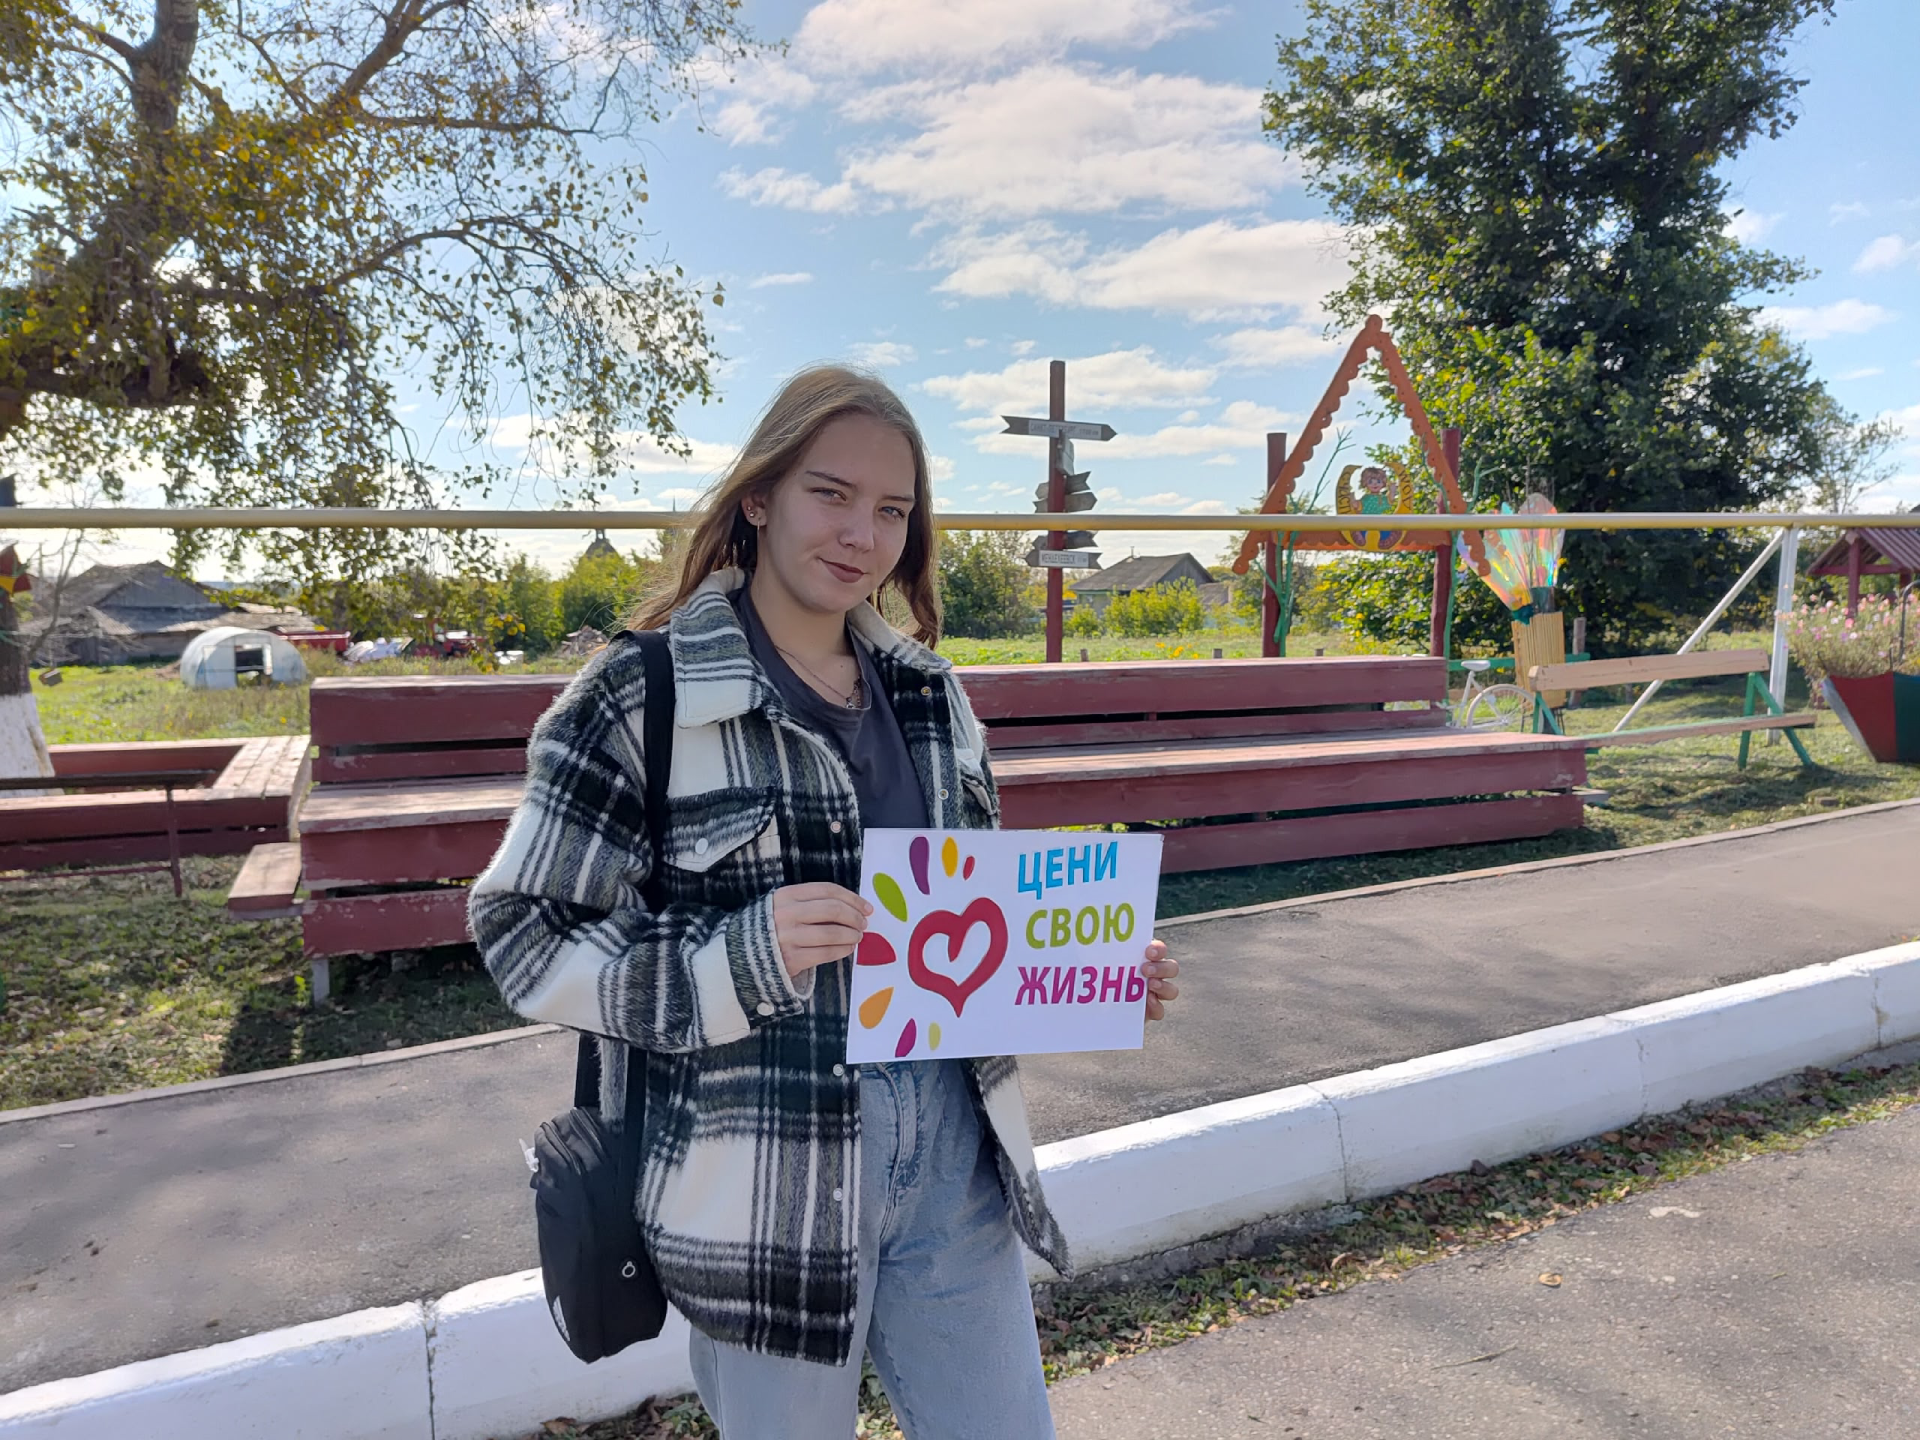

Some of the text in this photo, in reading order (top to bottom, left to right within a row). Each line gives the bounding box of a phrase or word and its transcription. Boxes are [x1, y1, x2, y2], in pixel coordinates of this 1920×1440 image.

[1016, 839, 1120, 901] ЦЕНИ
[1025, 902, 1135, 949] СВОЮ
[1014, 965, 1145, 1006] ЖИЗНЬ
